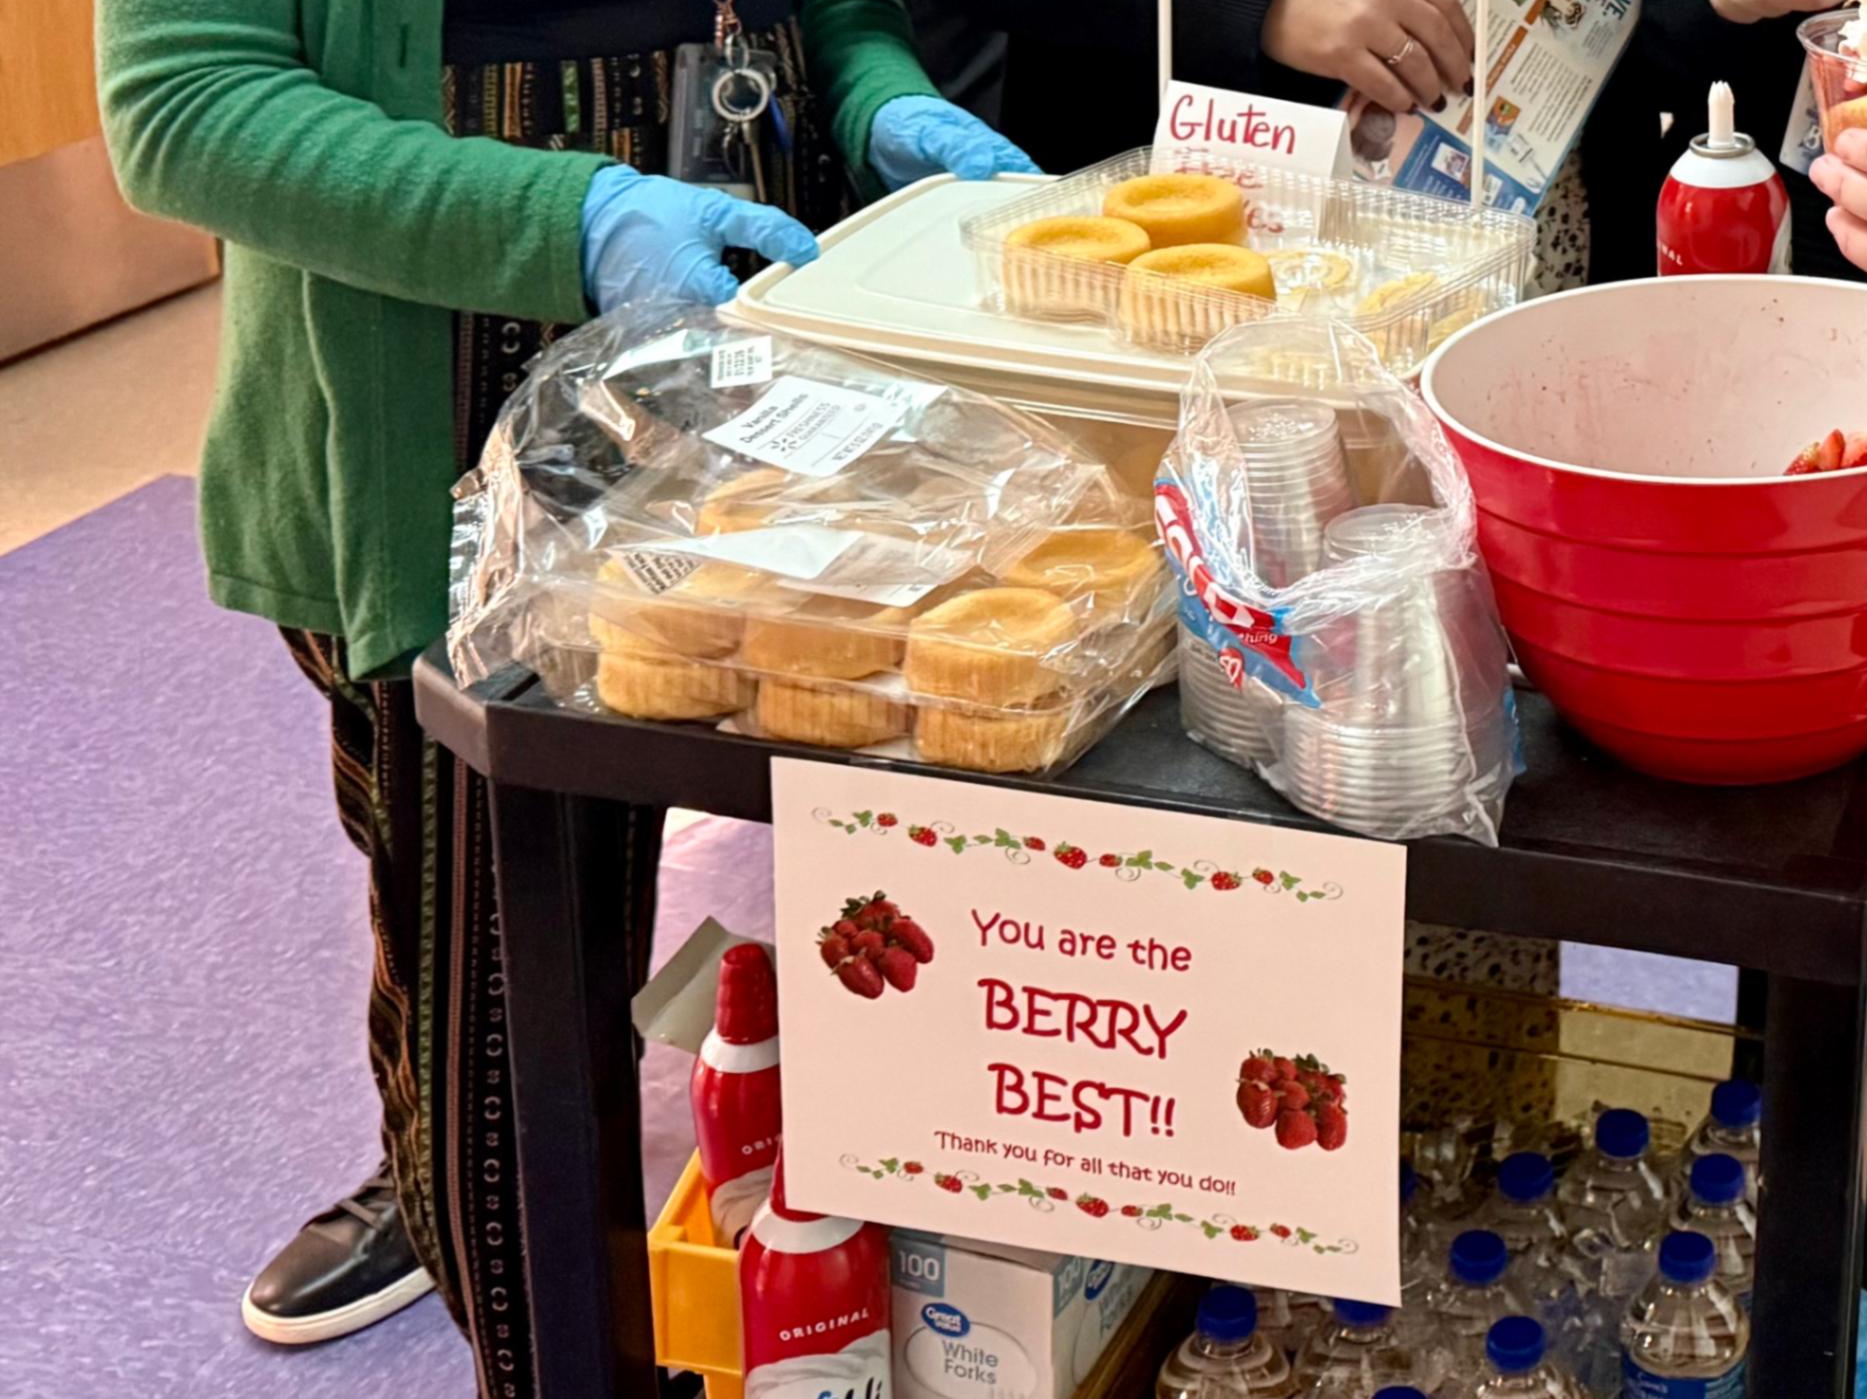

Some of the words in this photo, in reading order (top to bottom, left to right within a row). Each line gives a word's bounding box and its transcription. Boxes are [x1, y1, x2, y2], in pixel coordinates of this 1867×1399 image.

[1169, 94, 1297, 155] Gluten
[970, 908, 1046, 952] You
[1058, 928, 1117, 961] are
[1127, 937, 1193, 973] the
[976, 977, 1189, 1060] BERRY
[986, 1061, 1177, 1138] BEST!!
[934, 1130, 998, 1155] Thank
[1003, 1142, 1038, 1164] you
[1043, 1148, 1076, 1170] for
[1080, 1155, 1103, 1175] all
[1108, 1160, 1154, 1183] that
[1158, 1169, 1194, 1191] you
[1199, 1173, 1237, 1197] do!!
[899, 1251, 940, 1281] 100
[779, 1308, 869, 1341] ORIGINAL
[942, 1339, 999, 1368] White
[943, 1358, 997, 1385] Forks
